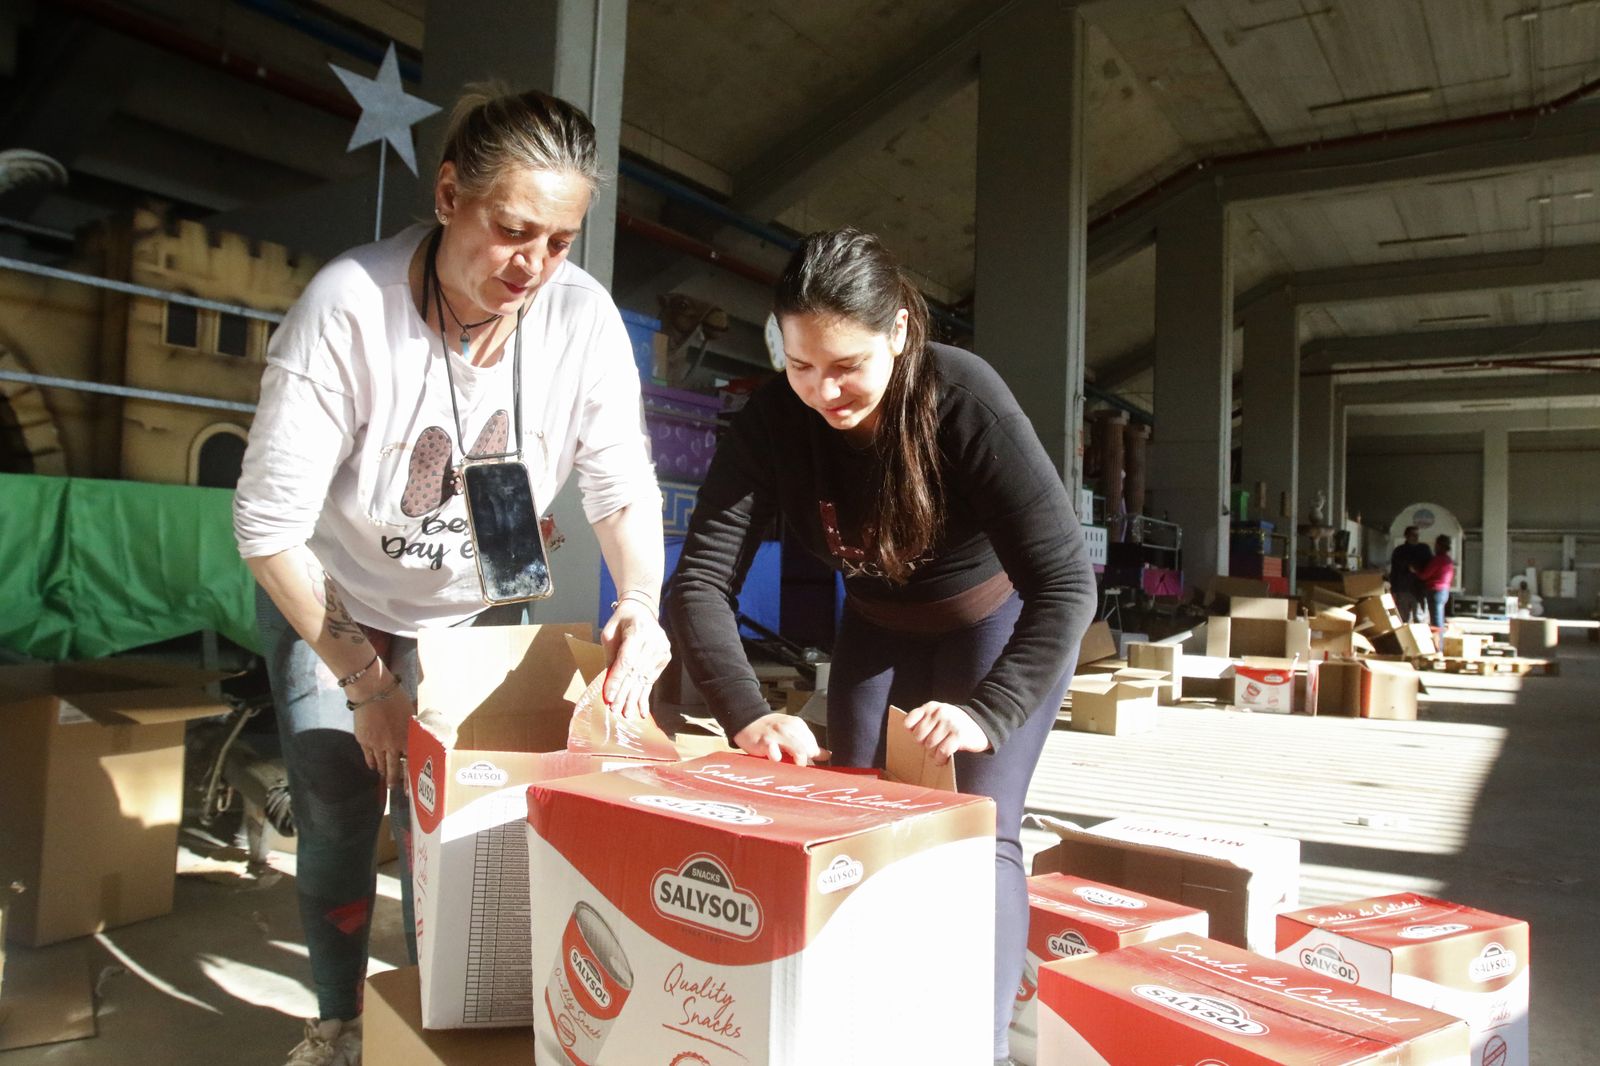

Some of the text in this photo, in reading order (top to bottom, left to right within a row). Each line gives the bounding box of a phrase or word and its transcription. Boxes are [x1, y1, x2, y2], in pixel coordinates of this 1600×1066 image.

[421, 513, 470, 536] Bes
[381, 535, 451, 571] Day
[460, 771, 503, 781] SALYSOL
[686, 764, 943, 812] Snacks de Calidad
[691, 867, 721, 884] SNACKS
[660, 880, 752, 928] SALYSOL
[1306, 898, 1423, 924] Snacks de Calidad
[571, 951, 609, 1005] SALYSOL
[1159, 943, 1421, 1025] Snacks de Calidad
[1304, 953, 1355, 982] SALYSOL
[662, 961, 736, 1020] Quality
[1145, 988, 1249, 1033] SALYSOL
[679, 995, 742, 1039] Snacks
